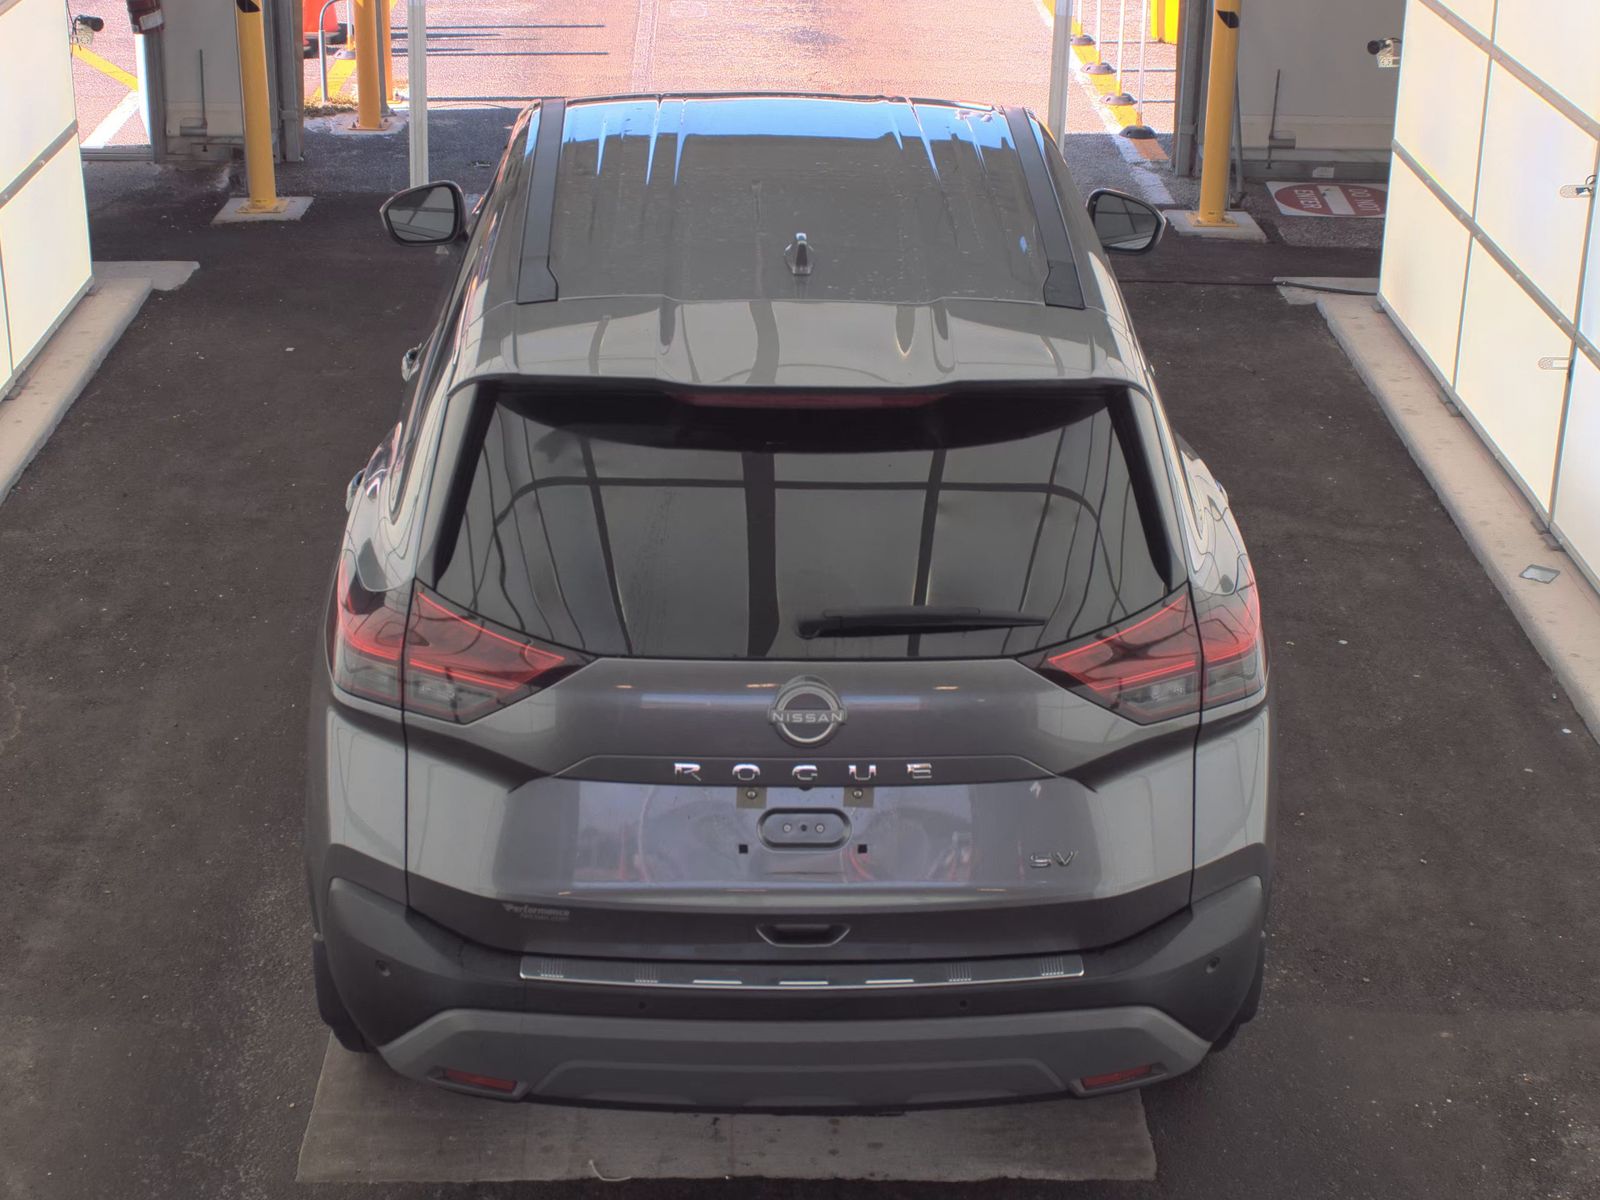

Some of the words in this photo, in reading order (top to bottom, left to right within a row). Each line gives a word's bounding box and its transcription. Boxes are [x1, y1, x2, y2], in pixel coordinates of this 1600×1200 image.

[1294, 189, 1322, 208] ENTER
[1348, 188, 1371, 197] DO
[1354, 199, 1381, 211] NOT
[772, 711, 844, 723] NISSAN
[674, 762, 932, 781] ROGUE
[1030, 851, 1077, 867] SV
